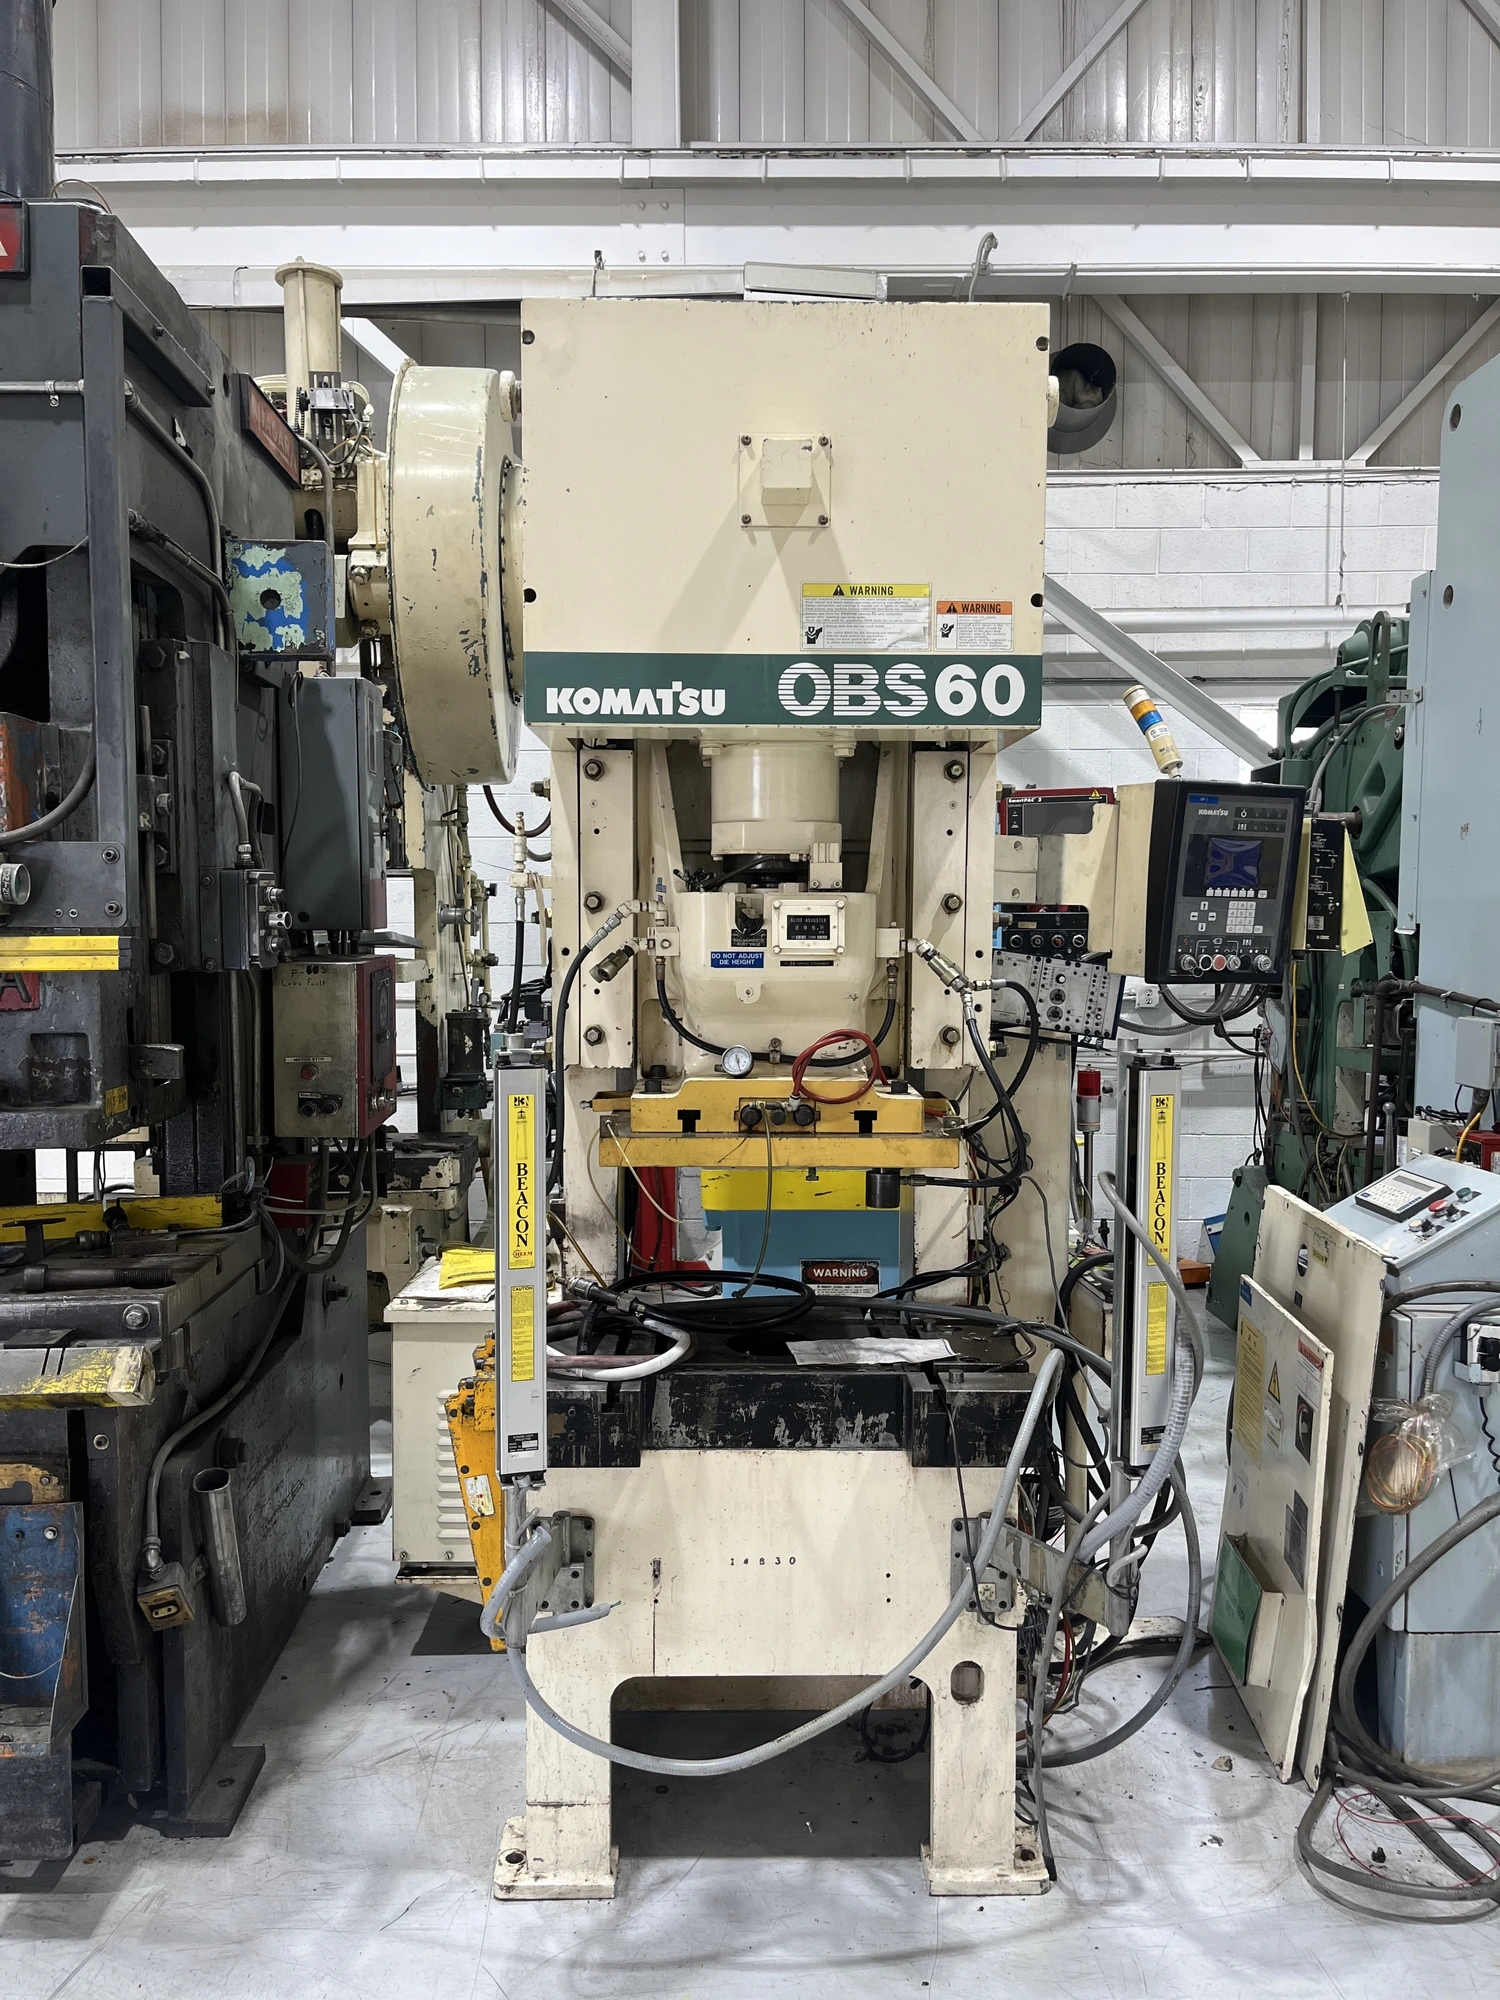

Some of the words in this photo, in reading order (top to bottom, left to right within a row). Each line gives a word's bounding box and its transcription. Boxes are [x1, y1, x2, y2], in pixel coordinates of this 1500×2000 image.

[849, 586, 894, 596] WARNING
[961, 603, 1002, 614] WARNING
[546, 681, 726, 716] KOMATSU
[1198, 808, 1229, 816] KOMATSU
[516, 1163, 530, 1248] BEACON
[1153, 1162, 1167, 1246] BEACON
[813, 1268, 868, 1278] WARNING
